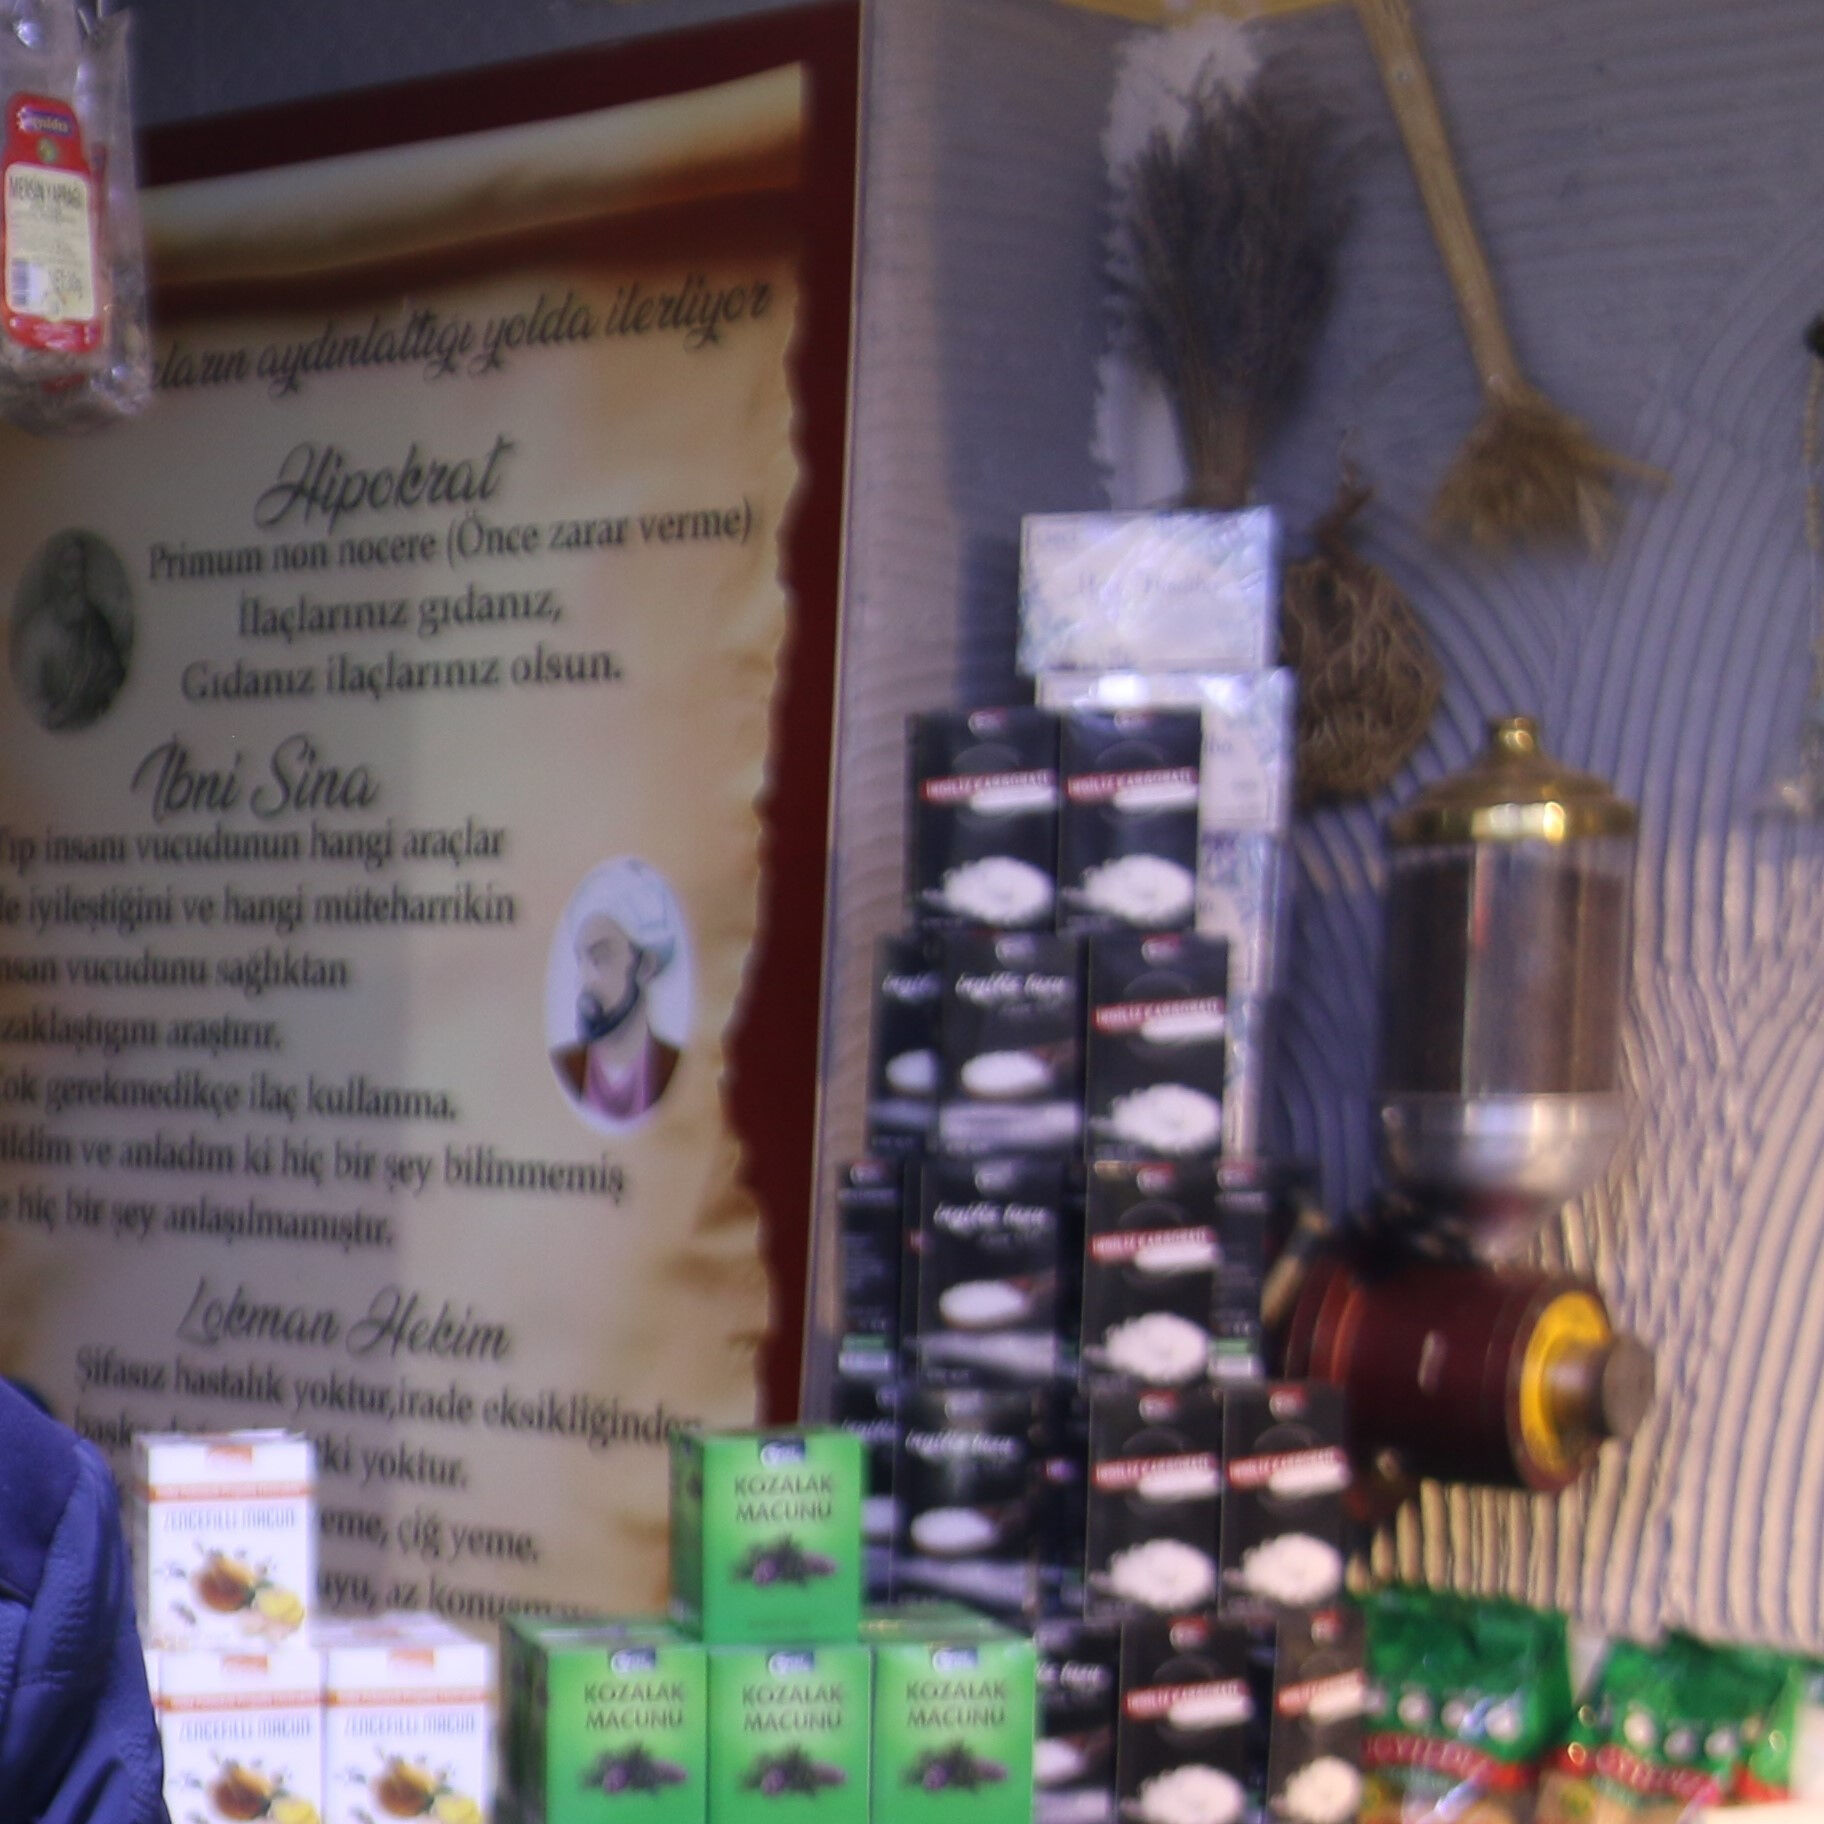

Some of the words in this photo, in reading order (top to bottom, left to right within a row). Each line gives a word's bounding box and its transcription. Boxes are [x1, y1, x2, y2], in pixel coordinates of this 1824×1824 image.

[253, 432, 517, 535] Hipokrat
[149, 542, 263, 582] Primum
[271, 545, 329, 577] non
[338, 530, 436, 573] nocere
[447, 508, 540, 571] (Önce
[549, 517, 629, 554] zarar
[637, 496, 754, 551] verme)
[179, 658, 316, 706] Gıdanız
[324, 650, 502, 706] ilaçlarınız
[510, 642, 624, 686] olsun.
[249, 734, 380, 819] Sina
[309, 817, 395, 873] hangi
[402, 816, 505, 870] araçlar
[182, 896, 215, 926] ve
[222, 883, 305, 937] hangi
[82, 1138, 113, 1169] ve
[175, 1276, 340, 1353] Lokman
[345, 1284, 513, 1363] Hekim
[734, 1472, 834, 1500] KOZALAK
[316, 1508, 389, 1550] eme,
[582, 1680, 685, 1705] KOZALAK
[740, 1681, 844, 1708] KOZALAK
[904, 1679, 1008, 1705] KOZALAK
